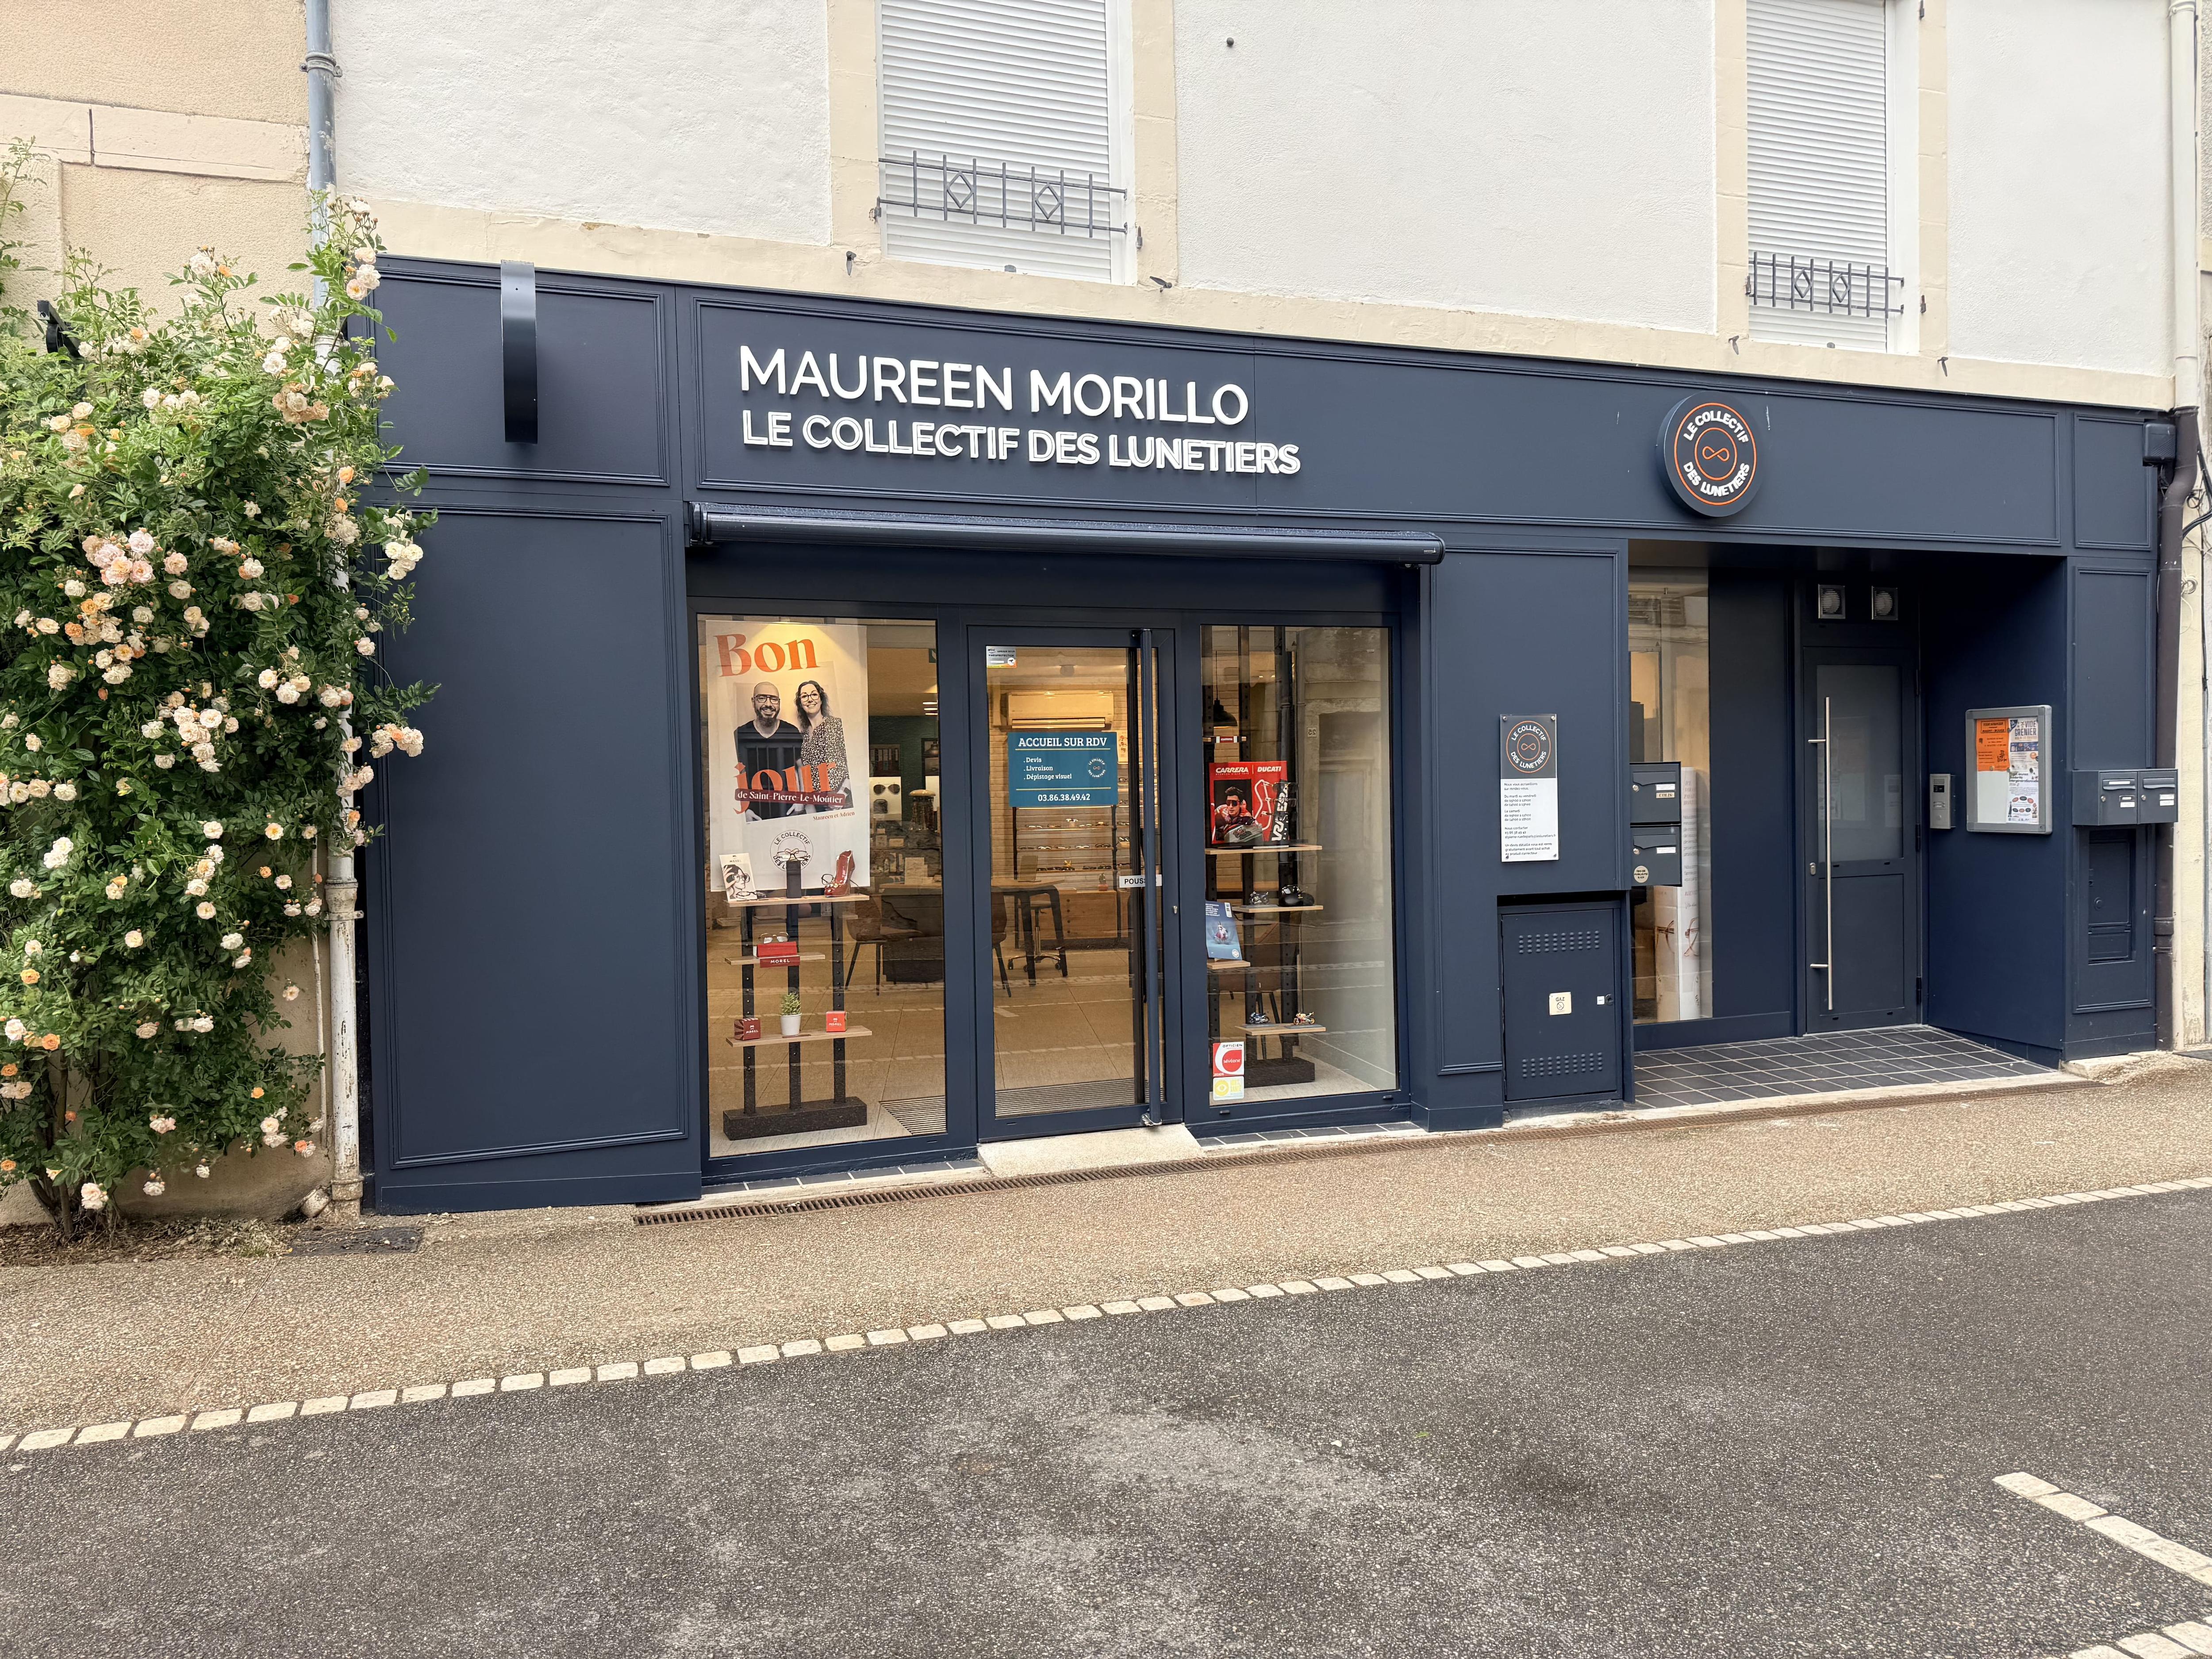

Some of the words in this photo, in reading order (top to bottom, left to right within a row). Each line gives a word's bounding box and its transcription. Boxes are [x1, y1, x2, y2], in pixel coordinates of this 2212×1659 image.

[740, 345, 1012, 411] MAUREEN
[1031, 369, 1248, 425] MORILLO
[1683, 422, 1698, 441] LE
[1695, 411, 1749, 443] COLLECTIF
[742, 409, 793, 447] LE
[803, 415, 1019, 461] COLLECTIF
[1029, 430, 1100, 466] DES
[1109, 434, 1301, 475] LUNETIERS
[1683, 461, 1701, 486] DES
[1700, 463, 1750, 496] LUNETIERS
[714, 633, 820, 677] Bon
[1018, 737, 1062, 747] ACCUEIL
[1064, 737, 1084, 747] SUR
[1086, 737, 1107, 746] RDV
[1511, 731, 1519, 741] LE
[1517, 725, 1546, 741] COLLECTIF
[2015, 728, 2036, 736] GRENIER
[1511, 751, 1520, 763] DES
[1520, 751, 1547, 768] LUNETIERS
[733, 760, 837, 814] jour
[1038, 793, 1091, 802] 03.86.38.49.42
[781, 832, 810, 845] COLLECTIF
